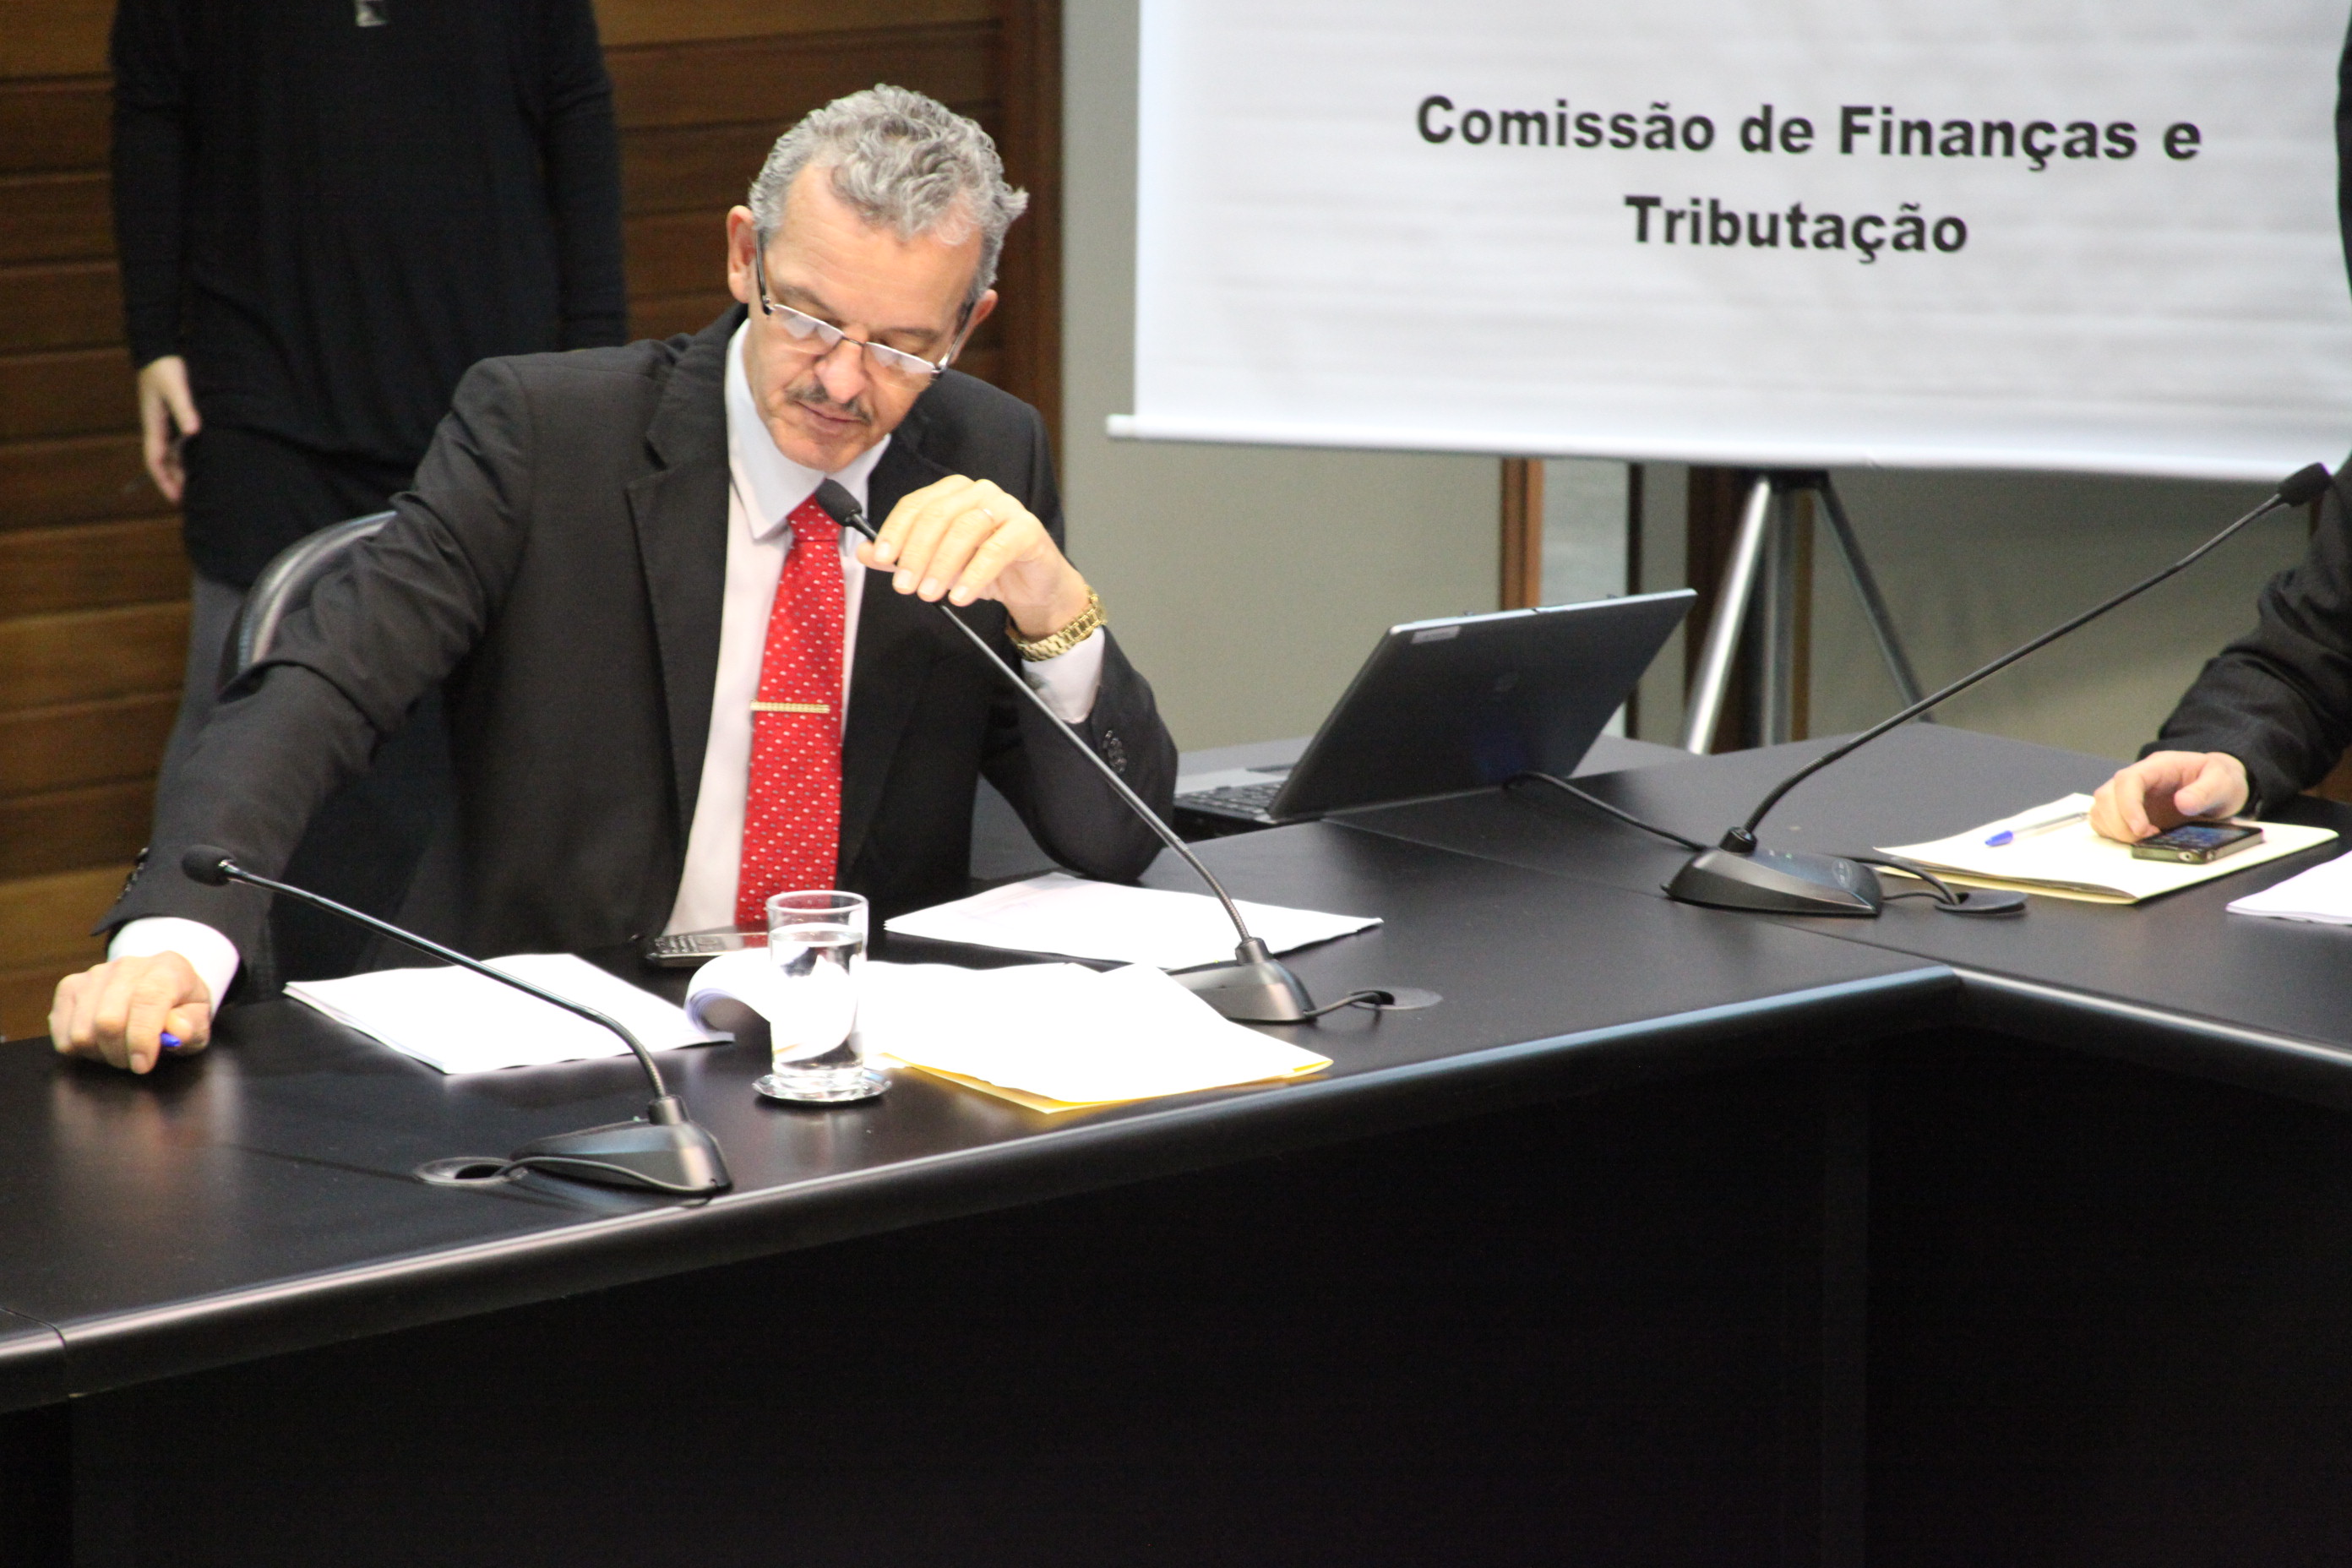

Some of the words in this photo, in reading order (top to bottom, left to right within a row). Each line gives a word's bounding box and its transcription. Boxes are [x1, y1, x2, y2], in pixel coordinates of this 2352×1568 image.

[1418, 95, 1714, 151] Comissão
[1740, 104, 1814, 154] de
[1841, 106, 2137, 172] Finanças
[2163, 122, 2201, 161] e
[1624, 195, 1967, 264] Tributação
